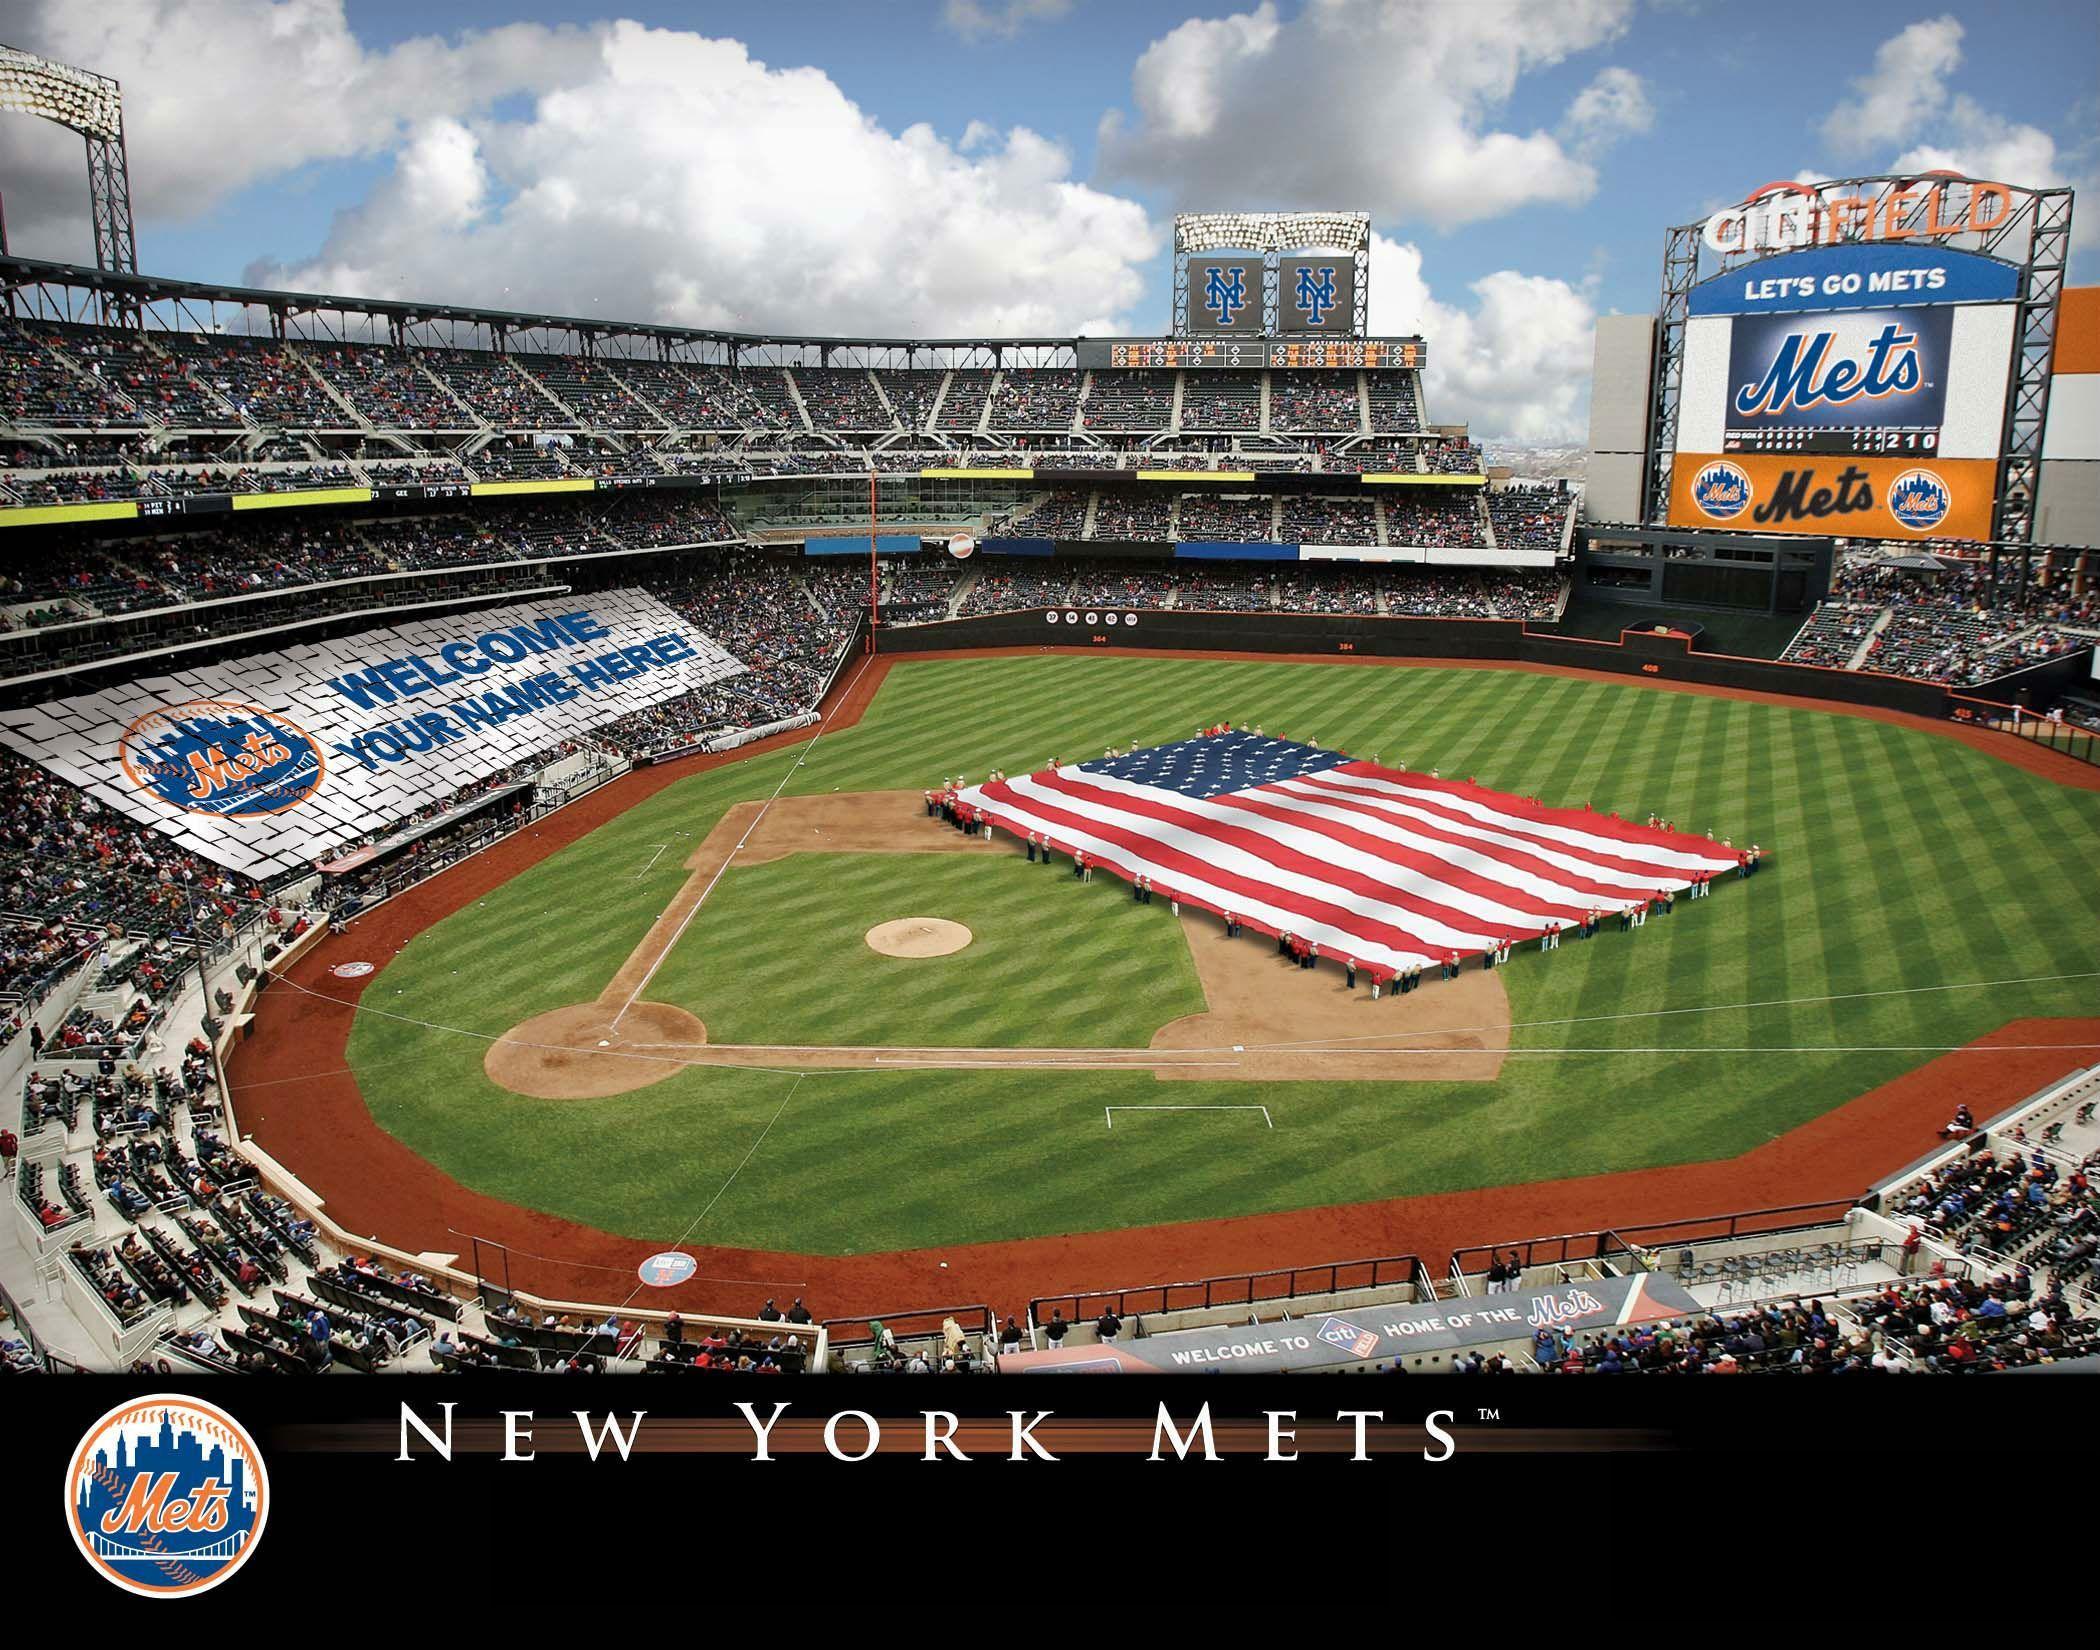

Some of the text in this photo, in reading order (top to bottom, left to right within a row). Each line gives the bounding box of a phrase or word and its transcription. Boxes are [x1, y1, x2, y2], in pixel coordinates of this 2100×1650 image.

[1829, 183, 2012, 243] FIELD
[1745, 267, 1946, 300] LET'S GO METS
[1736, 323, 1922, 416] Mets
[1886, 434, 1936, 449] 2 1 0
[1703, 481, 1741, 502] Mets
[1753, 465, 1874, 523] Mets
[1899, 489, 1938, 512] Mets
[325, 610, 612, 711] WELCOME
[333, 633, 698, 771] YOUR NAME HERE!
[186, 731, 292, 799] Mets
[1324, 1324, 1357, 1343] citi
[1383, 1288, 1606, 1337] HOME OF THE Mets
[1171, 1336, 1310, 1365] WELCOME TO
